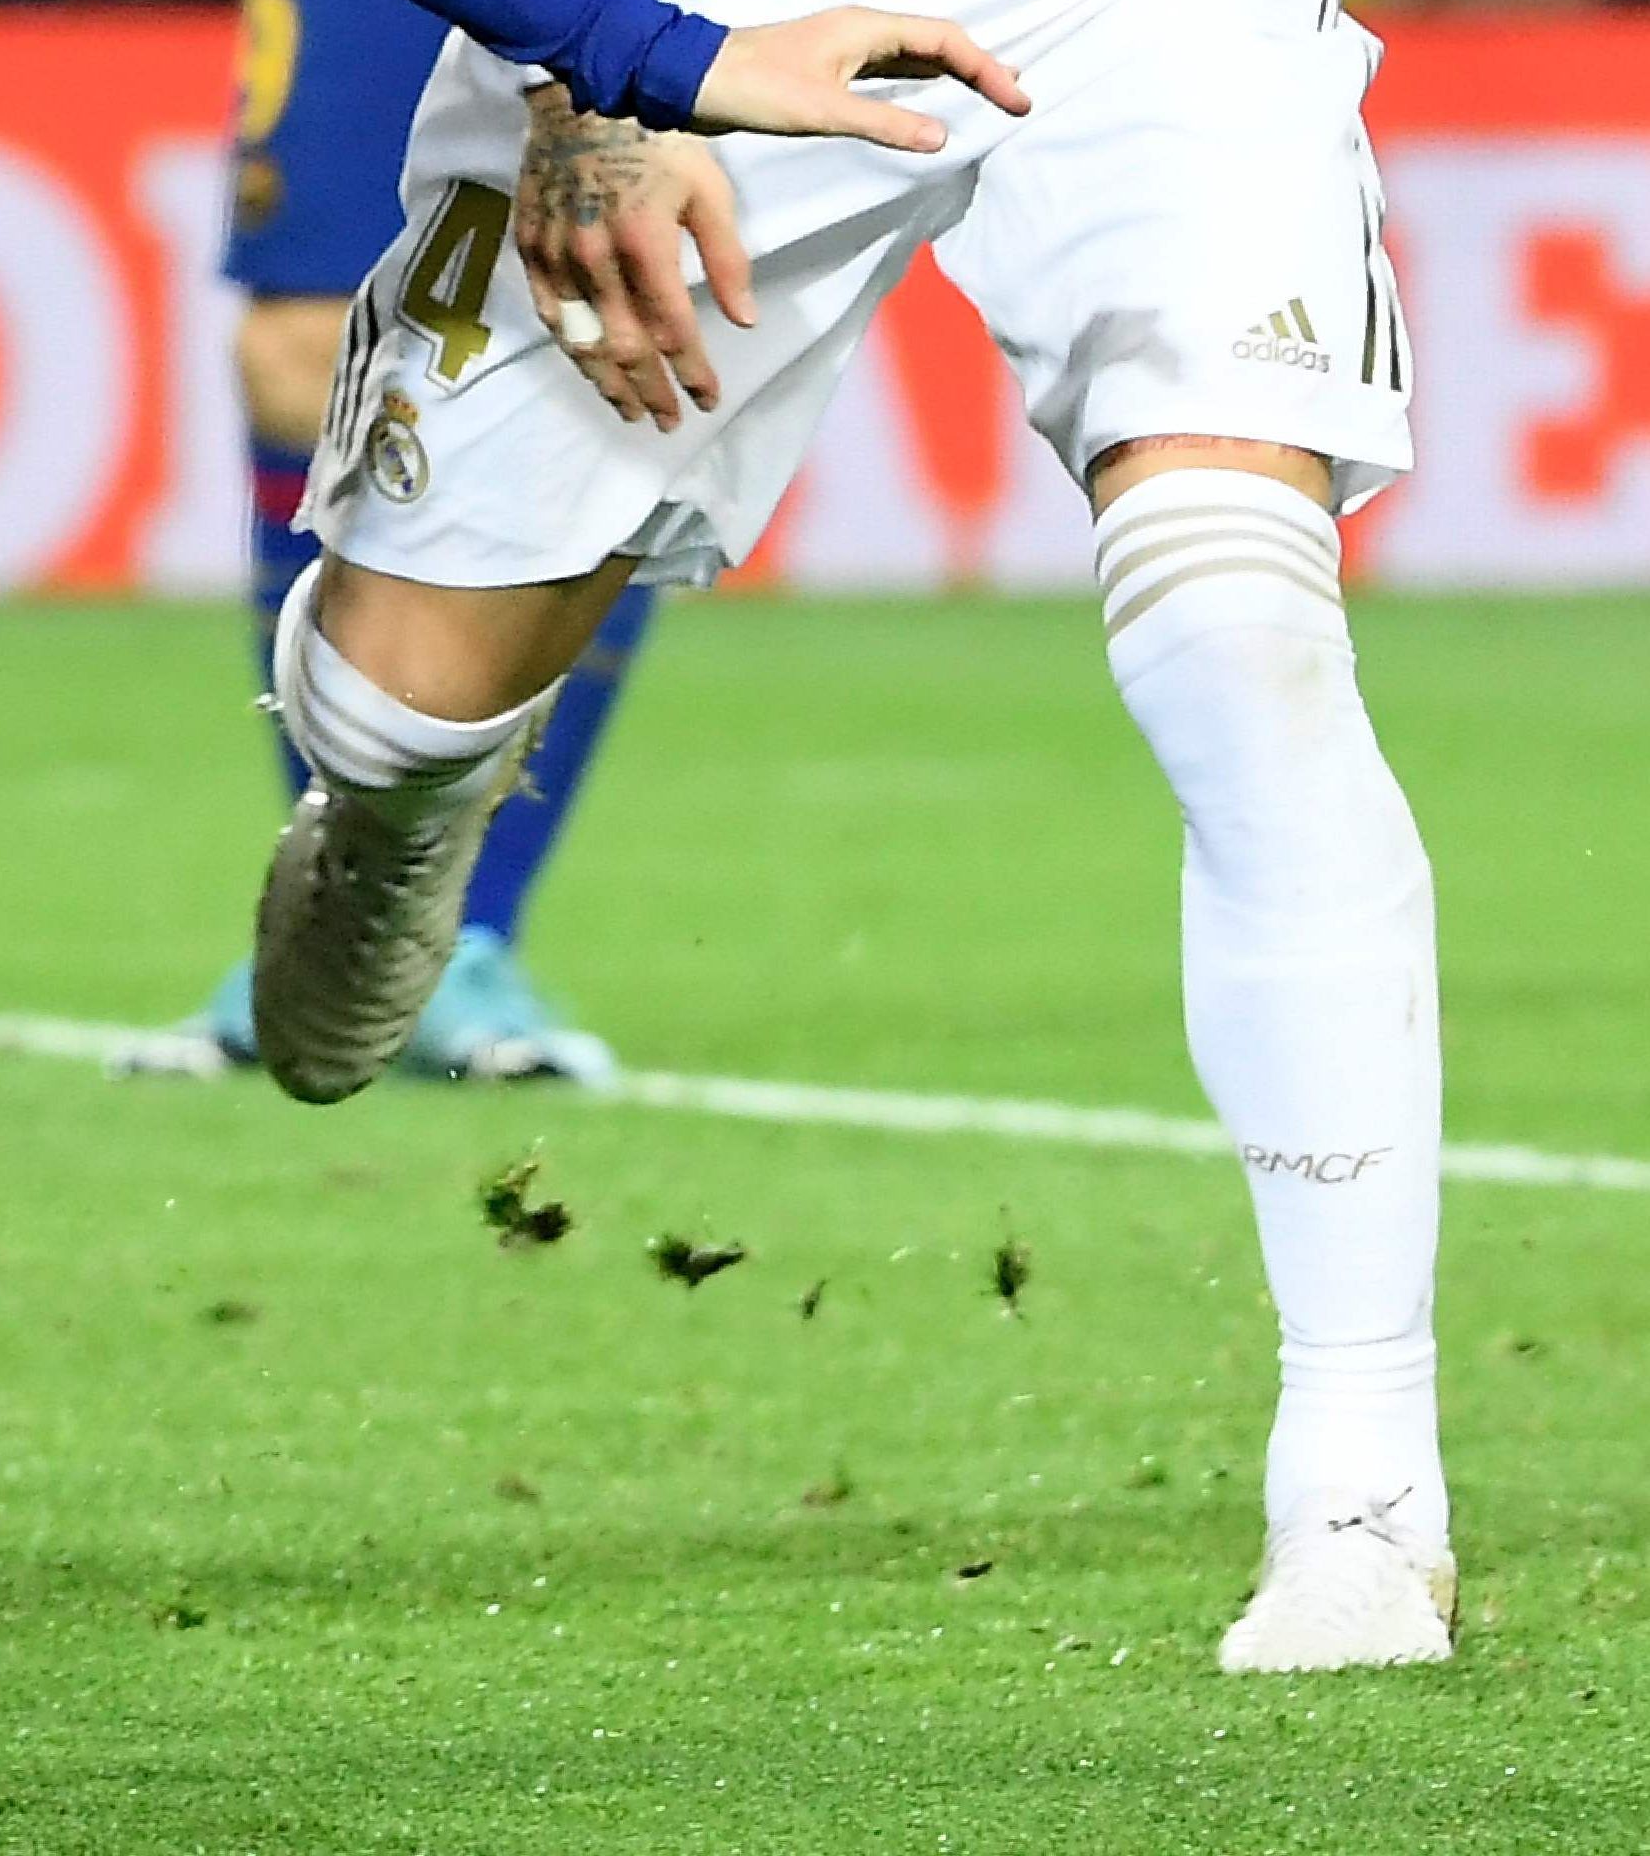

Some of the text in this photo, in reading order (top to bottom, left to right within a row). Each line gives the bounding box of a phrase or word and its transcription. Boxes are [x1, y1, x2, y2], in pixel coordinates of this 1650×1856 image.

[396, 177, 513, 398] 4
[1231, 337, 1331, 374] adidas
[1242, 1143, 1395, 1185] RMCF
